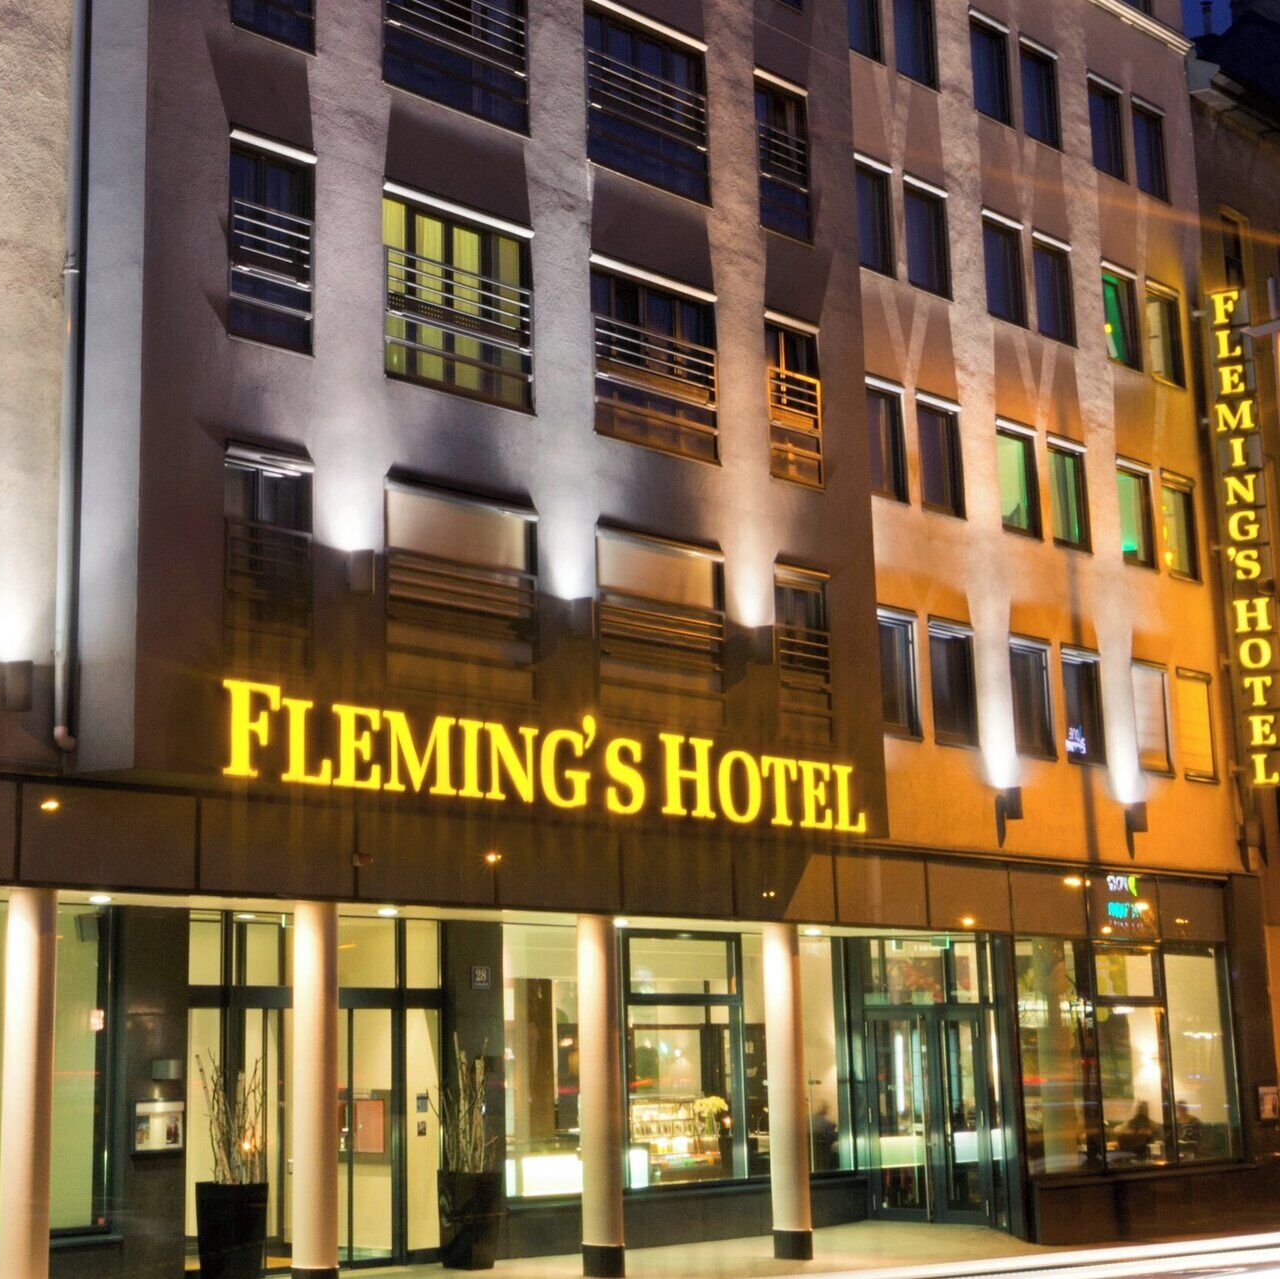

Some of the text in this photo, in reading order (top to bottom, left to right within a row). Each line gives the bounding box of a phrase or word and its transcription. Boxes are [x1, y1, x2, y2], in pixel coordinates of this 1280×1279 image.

[1210, 290, 1280, 785] FLEMING'S HOTEL
[221, 678, 868, 834] FLEMING'S HOTEL
